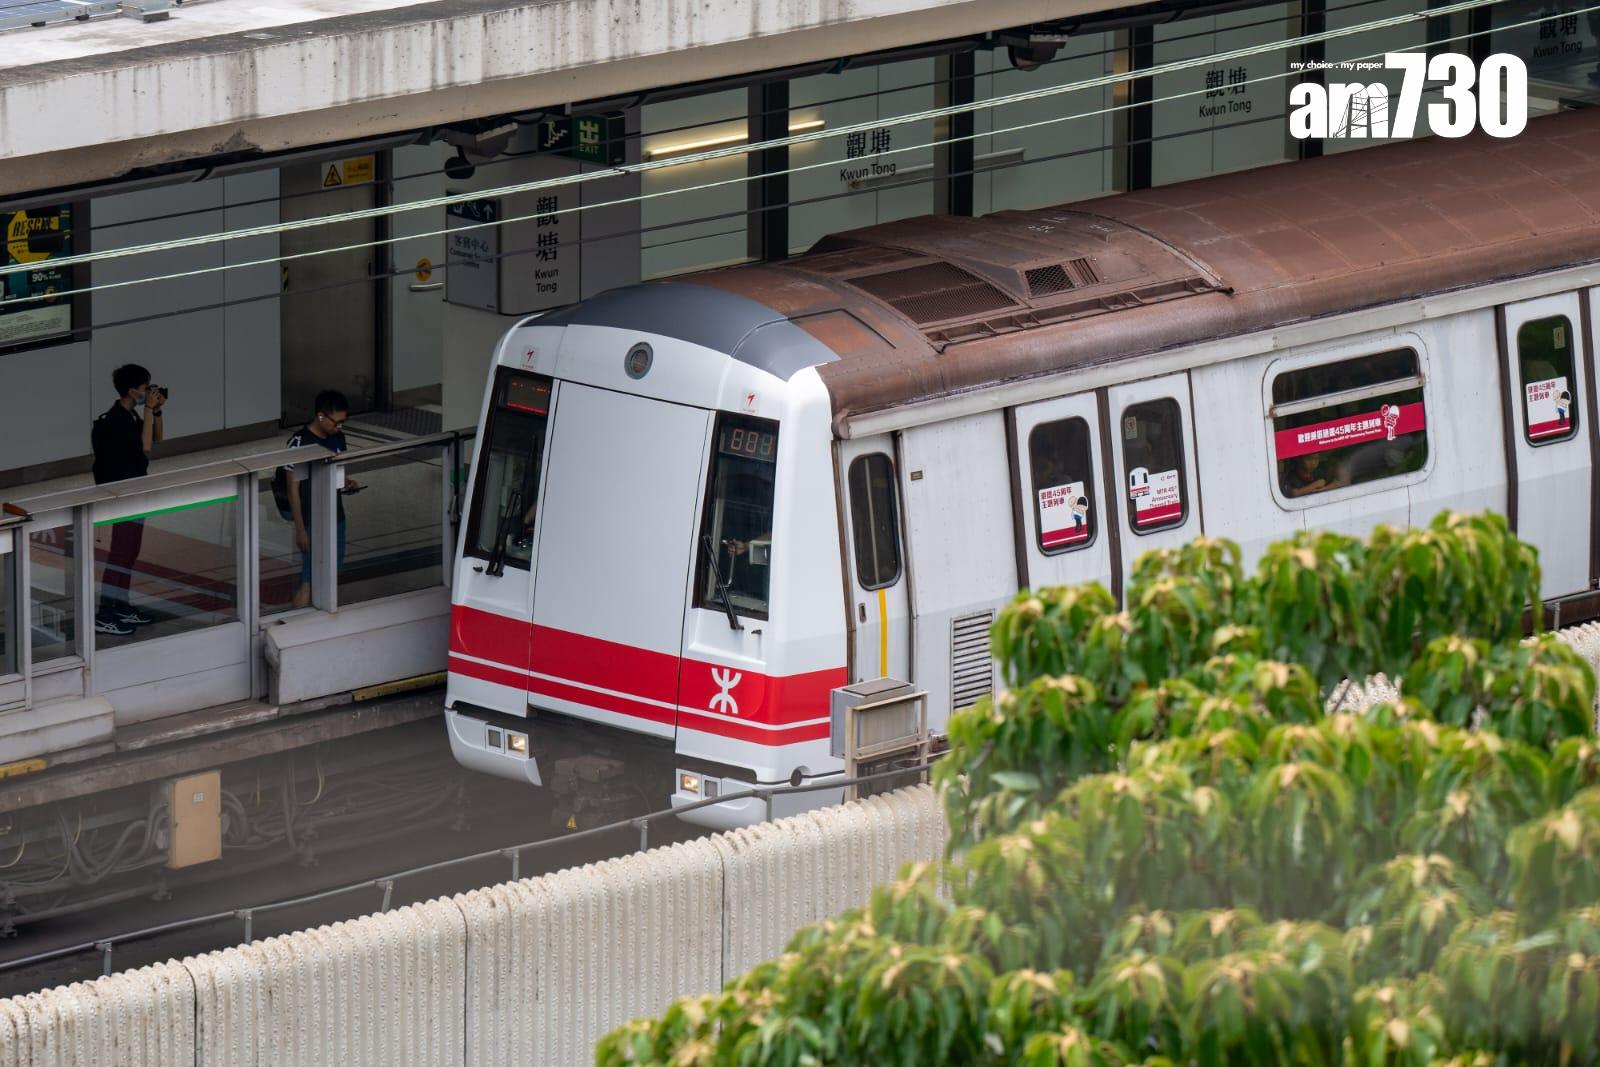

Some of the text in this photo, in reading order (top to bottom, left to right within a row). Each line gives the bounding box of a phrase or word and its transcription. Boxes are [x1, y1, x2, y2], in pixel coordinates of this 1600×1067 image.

[1533, 41, 1582, 57] Kwun Tong
[1205, 66, 1247, 99] 觀塘
[1199, 100, 1252, 118] Kwun Tong
[579, 120, 599, 144] 出
[578, 144, 599, 154] EXIT
[846, 128, 891, 160] 觀塘
[840, 163, 896, 181] Kwun Tong
[535, 269, 559, 280] Kwun
[536, 282, 557, 293] Tong
